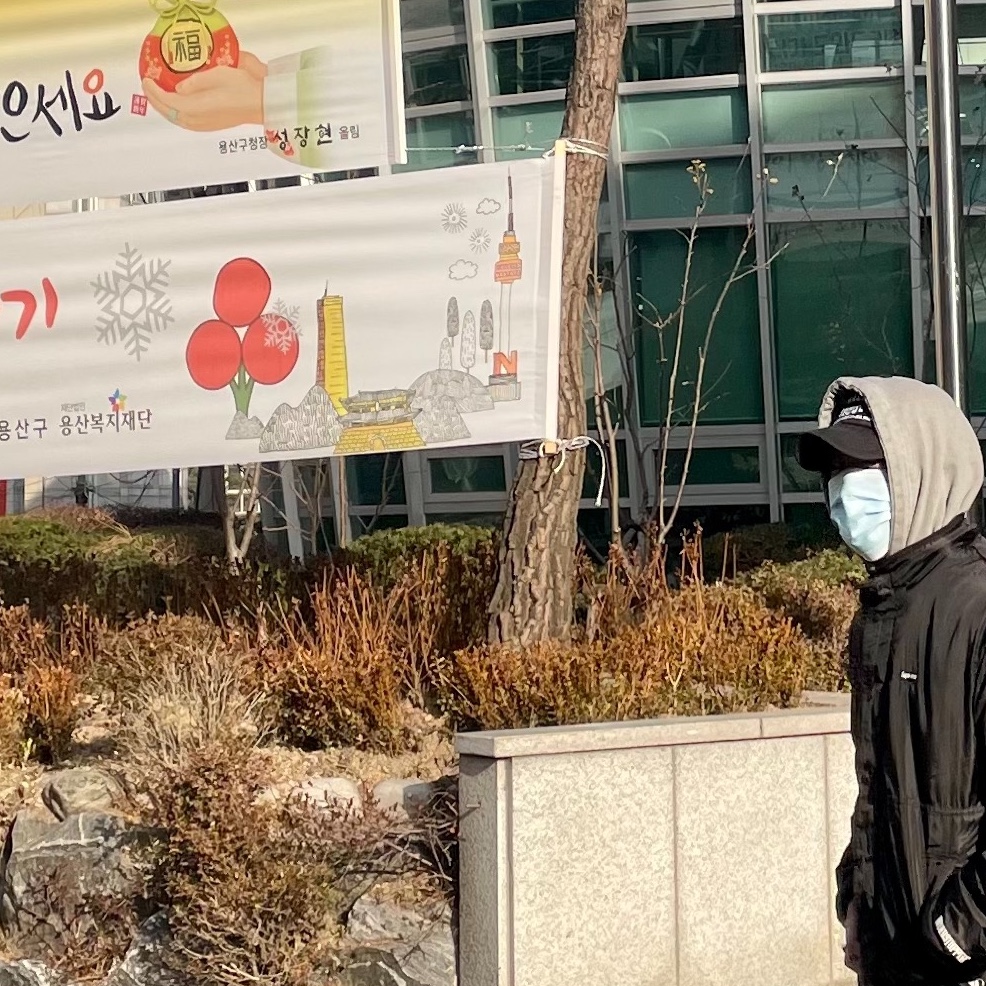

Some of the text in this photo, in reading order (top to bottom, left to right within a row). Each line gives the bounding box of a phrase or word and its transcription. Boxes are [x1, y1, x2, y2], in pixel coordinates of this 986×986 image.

[171, 28, 202, 63] 福
[218, 122, 360, 155] 용산구청장 성장현 올림
[0, 276, 59, 340] 기
[493, 350, 518, 376] N
[0, 408, 153, 442] 용산구 용산복지재단
